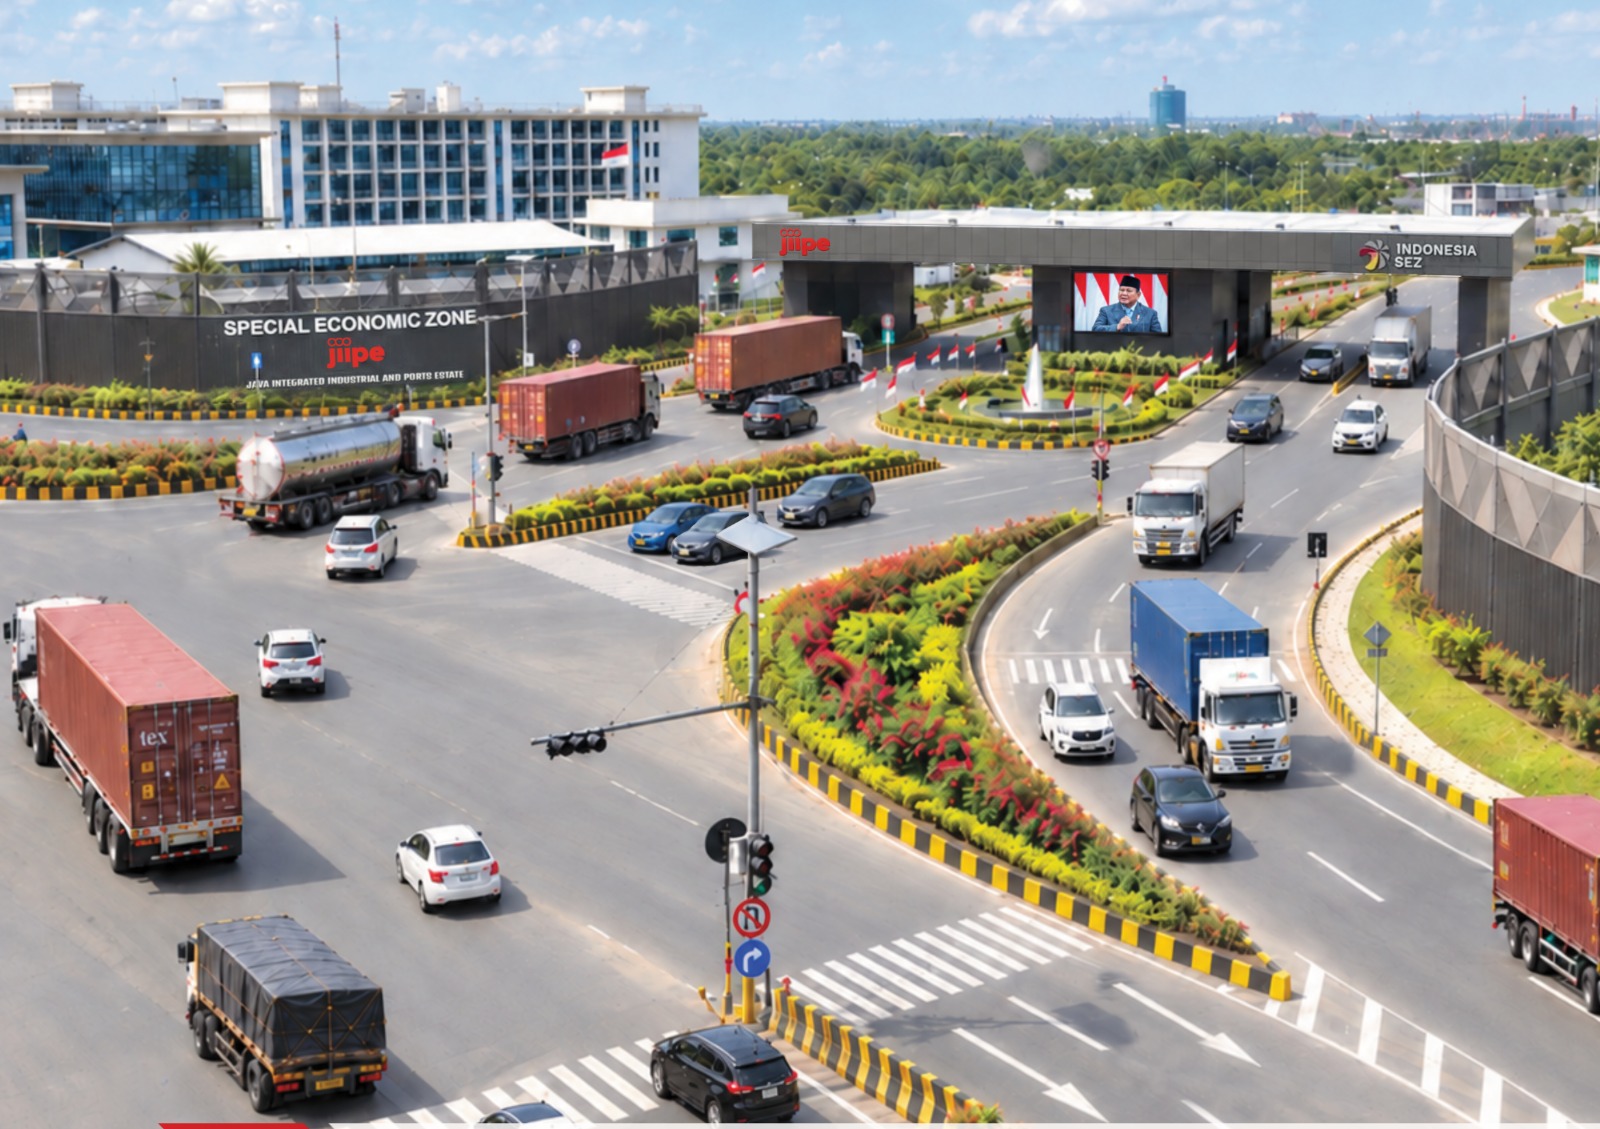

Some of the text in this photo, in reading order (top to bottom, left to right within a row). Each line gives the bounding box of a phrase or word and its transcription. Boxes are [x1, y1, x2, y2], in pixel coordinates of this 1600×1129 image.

[779, 228, 831, 256] jiipe
[1396, 243, 1477, 256] INDONESIA
[1394, 256, 1422, 268] SEZ
[224, 309, 477, 336] SPECIAL ECONOMIC ZONE
[327, 337, 385, 368] jiipe
[246, 370, 464, 389] JAVA INTEGRATED INDUSTRIAL AND PORTS ESTATE
